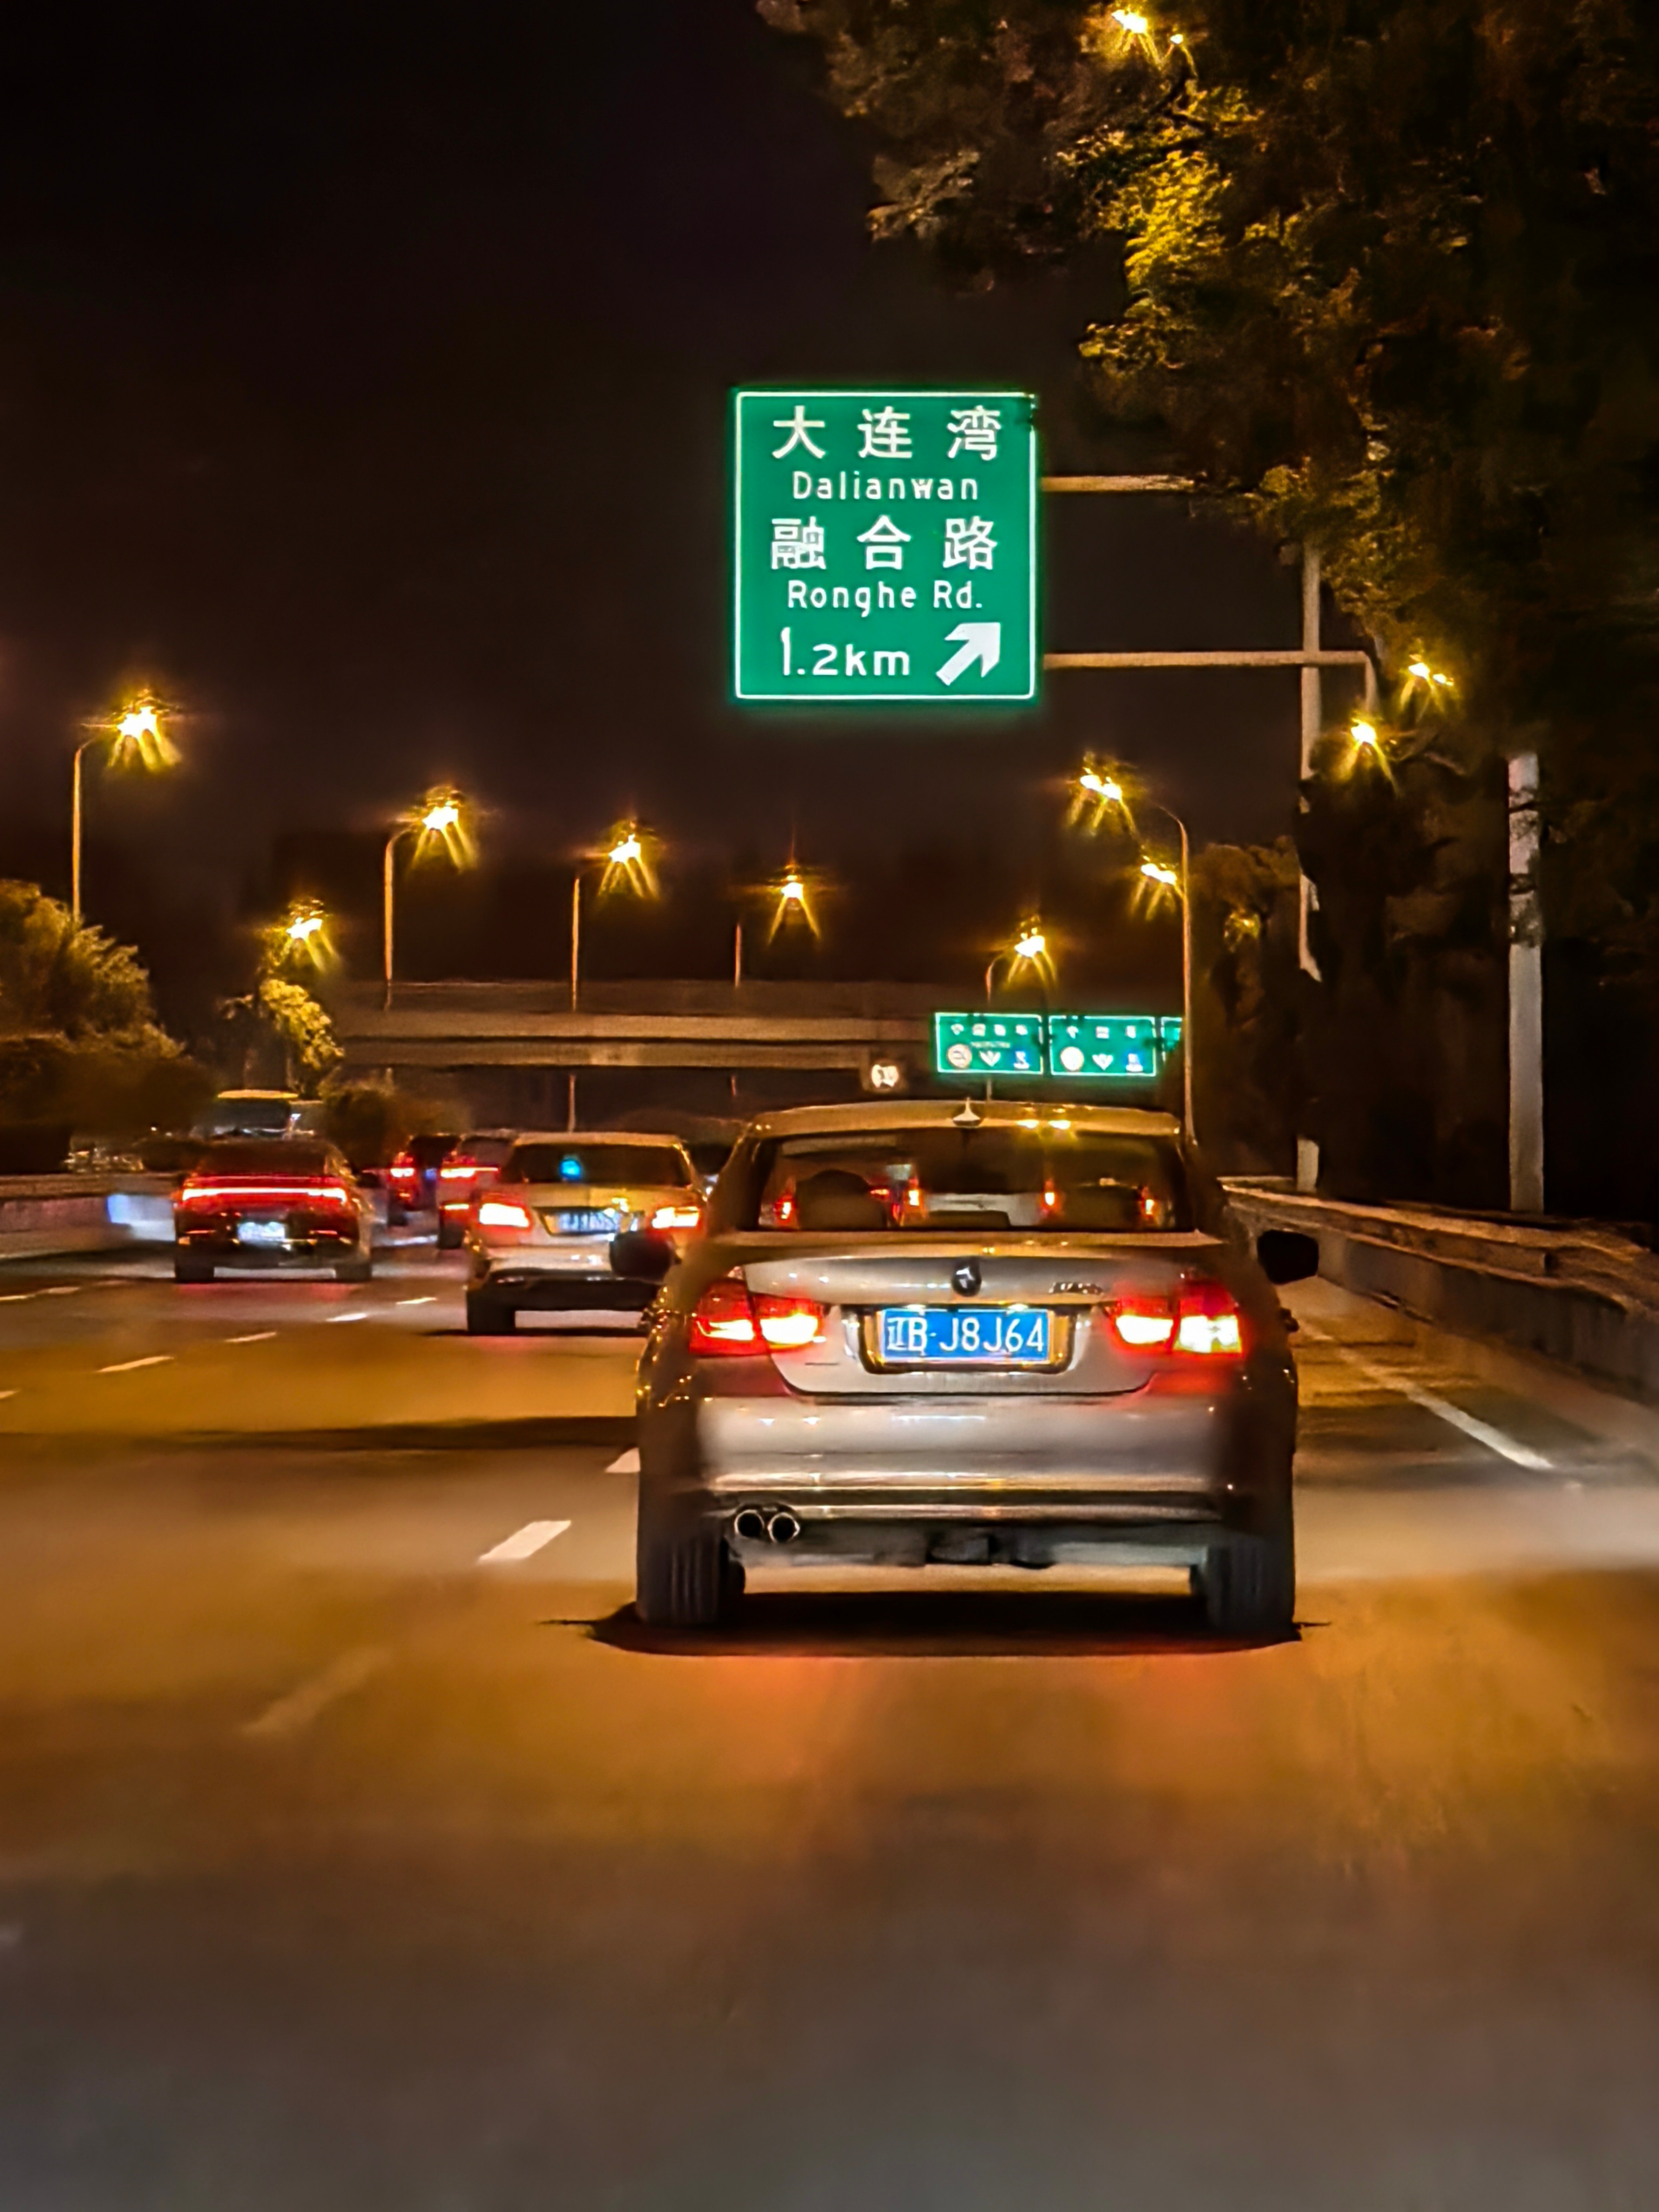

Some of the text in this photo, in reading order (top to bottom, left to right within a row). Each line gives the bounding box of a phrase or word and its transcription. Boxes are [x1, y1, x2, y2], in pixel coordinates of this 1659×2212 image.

[772, 405, 1001, 461] 大连湾
[793, 471, 978, 500] Dalianwan
[771, 515, 997, 570] 融合路
[788, 580, 982, 617] Ronghe Rd.
[780, 627, 910, 676] 1.2km
